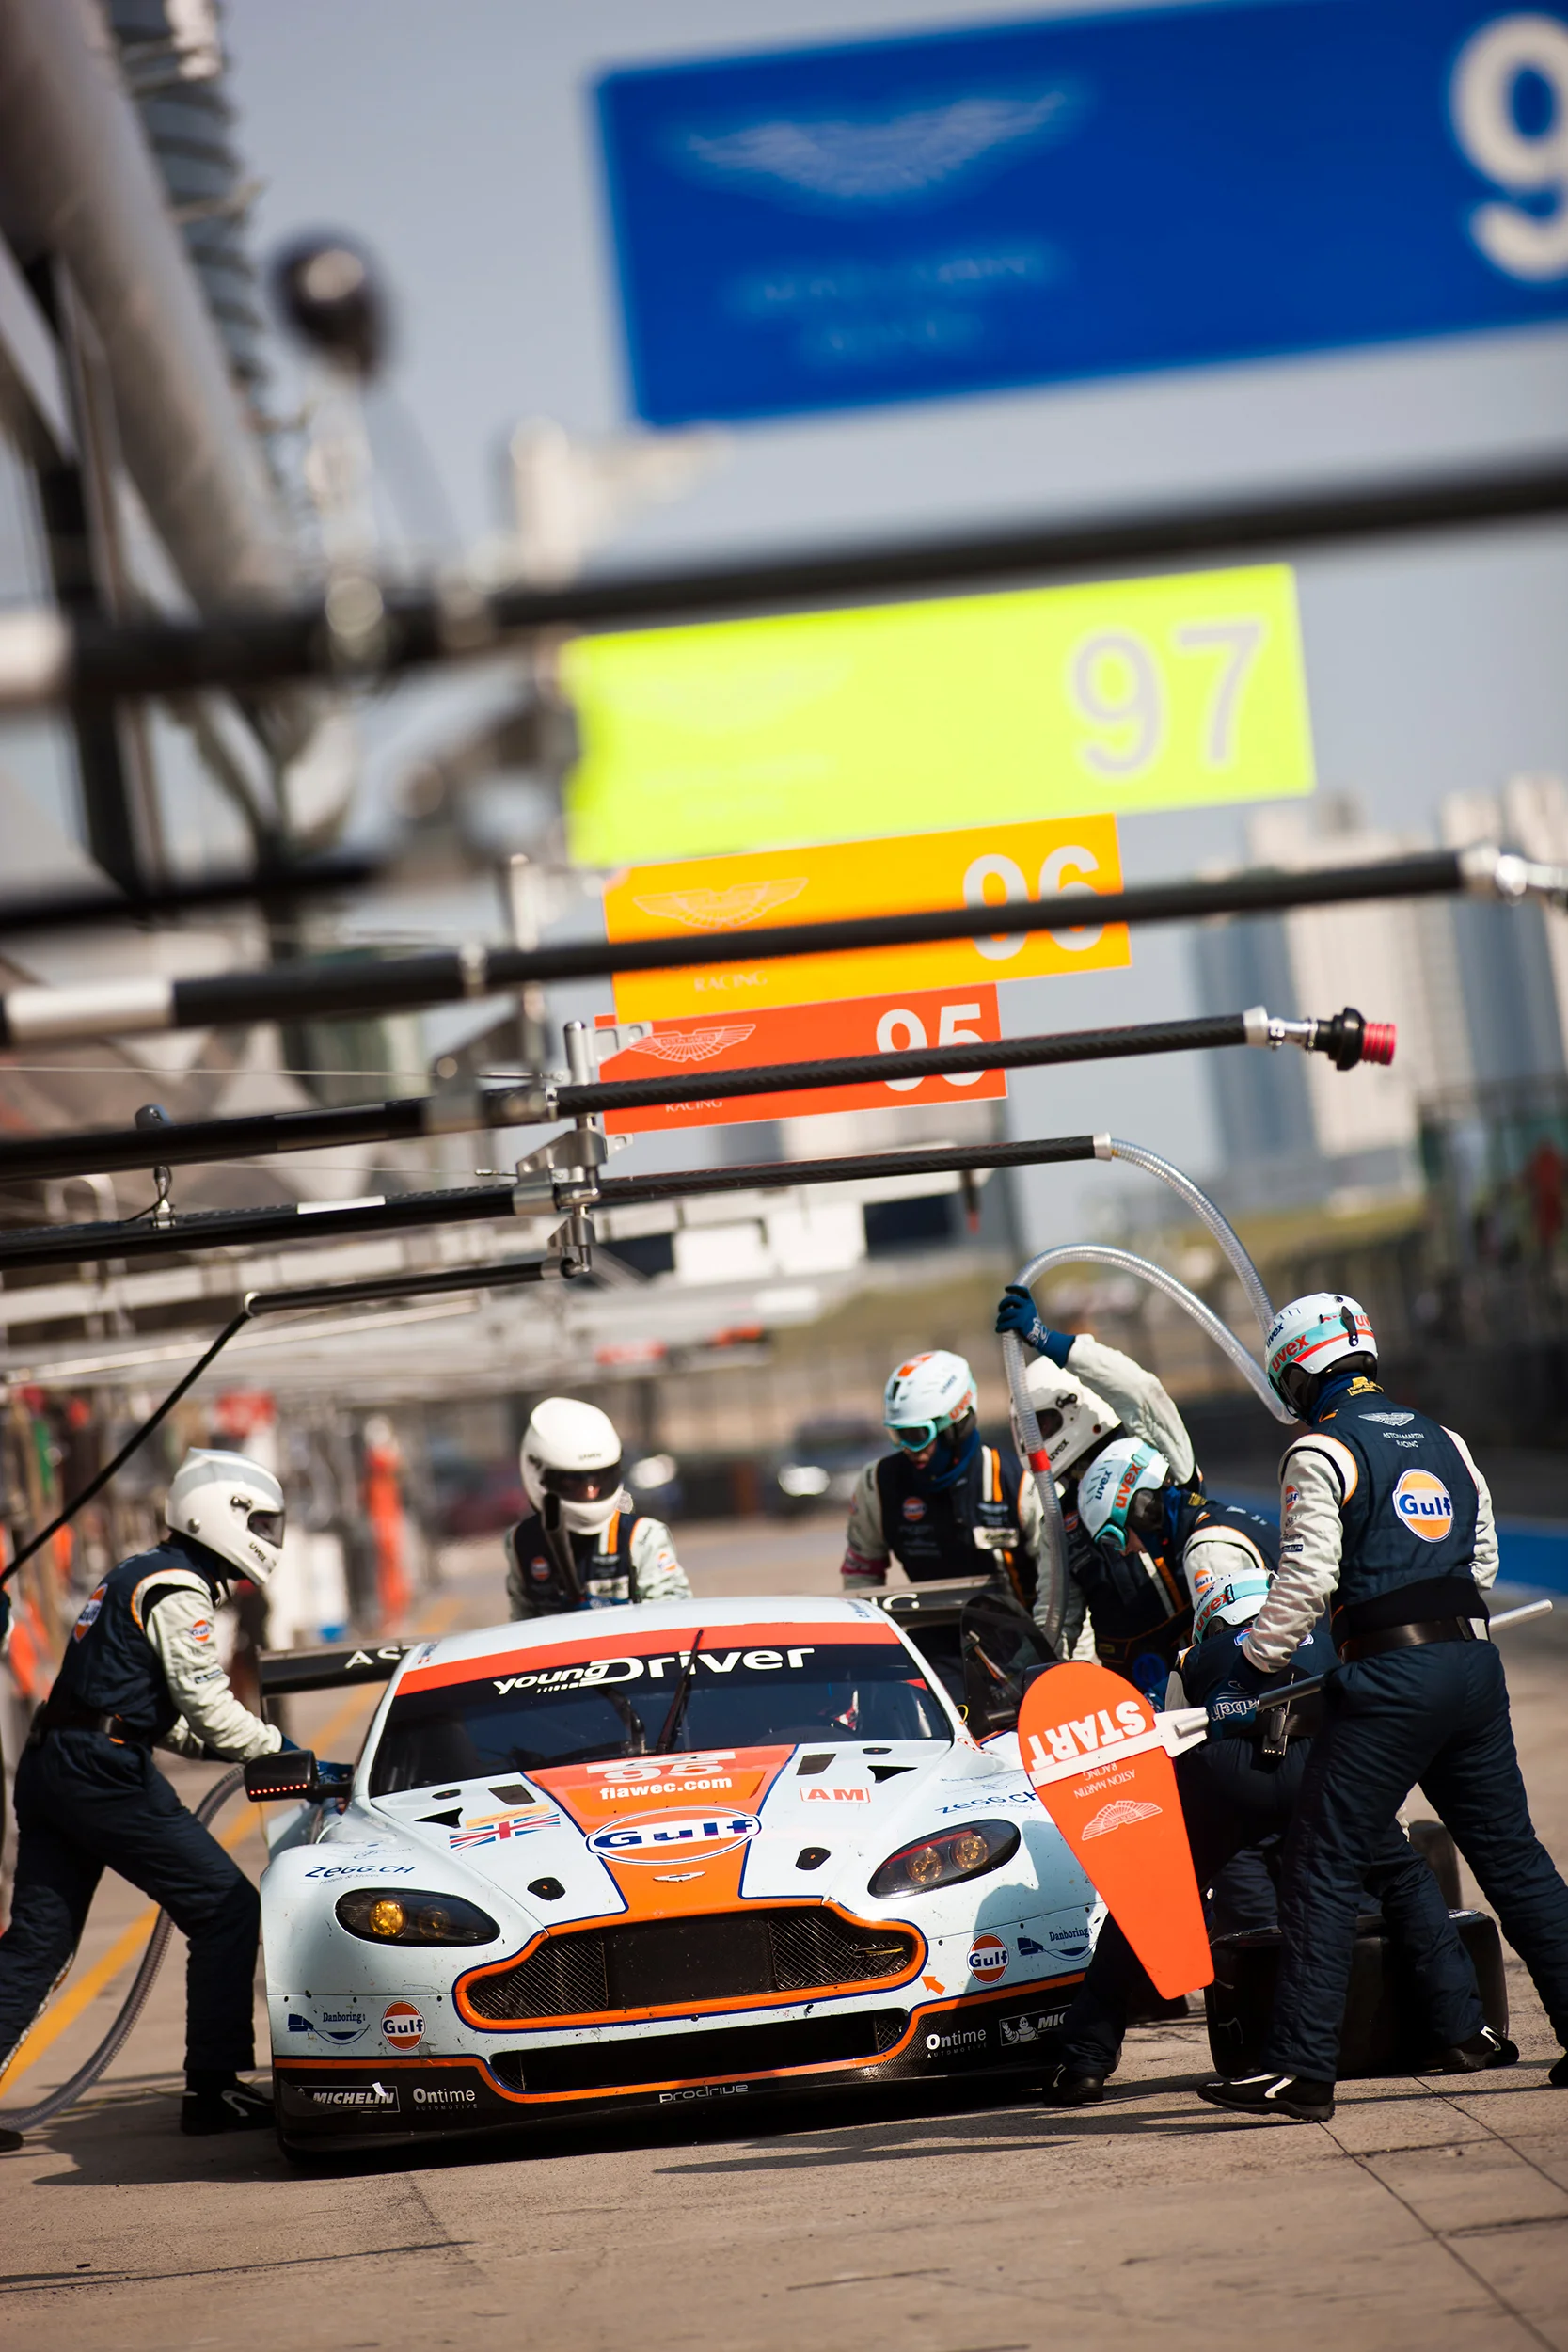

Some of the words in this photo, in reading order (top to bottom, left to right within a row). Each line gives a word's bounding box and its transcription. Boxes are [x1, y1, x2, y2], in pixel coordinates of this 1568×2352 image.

[1073, 619, 1265, 779] 97
[962, 845, 1106, 961] 96
[693, 969, 768, 993] RACING
[876, 1003, 988, 1091] 95
[1266, 1322, 1285, 1348] uvex
[1271, 1334, 1310, 1373] uvex
[1048, 1438, 1069, 1462] uvex
[1094, 1470, 1113, 1501] uvex
[1115, 1461, 1143, 1509] uvex
[1398, 1493, 1451, 1516] Gulf
[1196, 1588, 1232, 1632] uvex
[1028, 1701, 1146, 1771] START
[604, 1760, 724, 1784] 95
[1083, 1762, 1118, 1781] RACING
[1109, 1769, 1136, 1787] ASTON
[807, 1788, 864, 1801] AM
[1073, 1779, 1107, 1799] MARTIN
[594, 1820, 753, 1848] Gulf
[1049, 1927, 1090, 1942] Danboring
[969, 1950, 1008, 1968] Gulf
[322, 2011, 362, 2024] Danboring
[383, 2018, 424, 2034] Gulf
[926, 2028, 987, 2051] Ontime
[927, 2042, 987, 2058] AUTOMOTIVE
[413, 2088, 476, 2104] Ontime
[659, 2084, 749, 2104] prodrive
